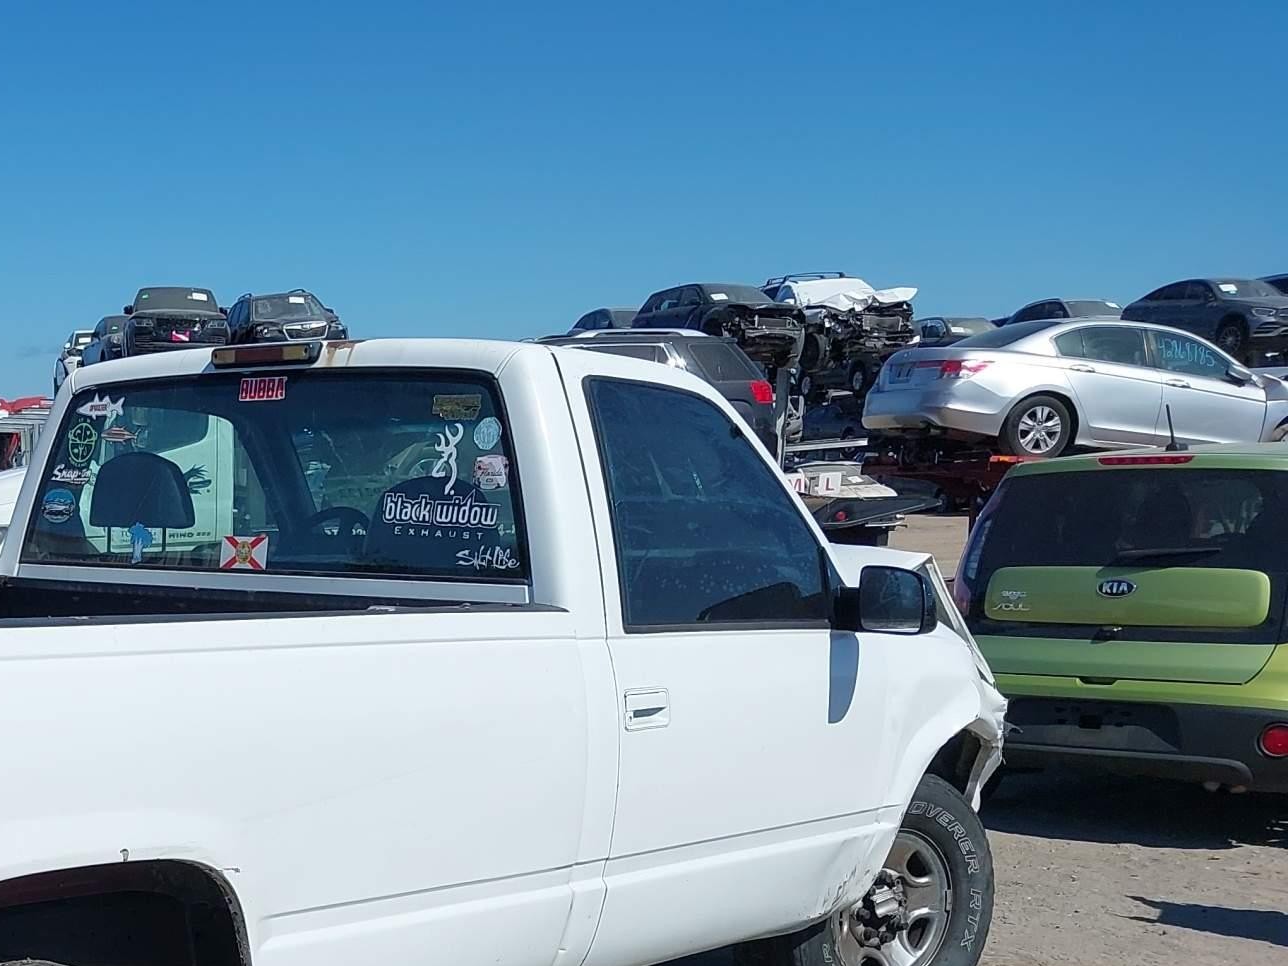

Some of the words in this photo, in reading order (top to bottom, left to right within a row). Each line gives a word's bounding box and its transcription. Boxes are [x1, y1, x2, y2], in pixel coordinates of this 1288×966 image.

[825, 477, 835, 491] L
[384, 492, 433, 525] black
[434, 489, 501, 528] widow
[394, 526, 484, 541] EXHAUST
[908, 800, 980, 875] OVERER
[960, 887, 982, 953] RTX
